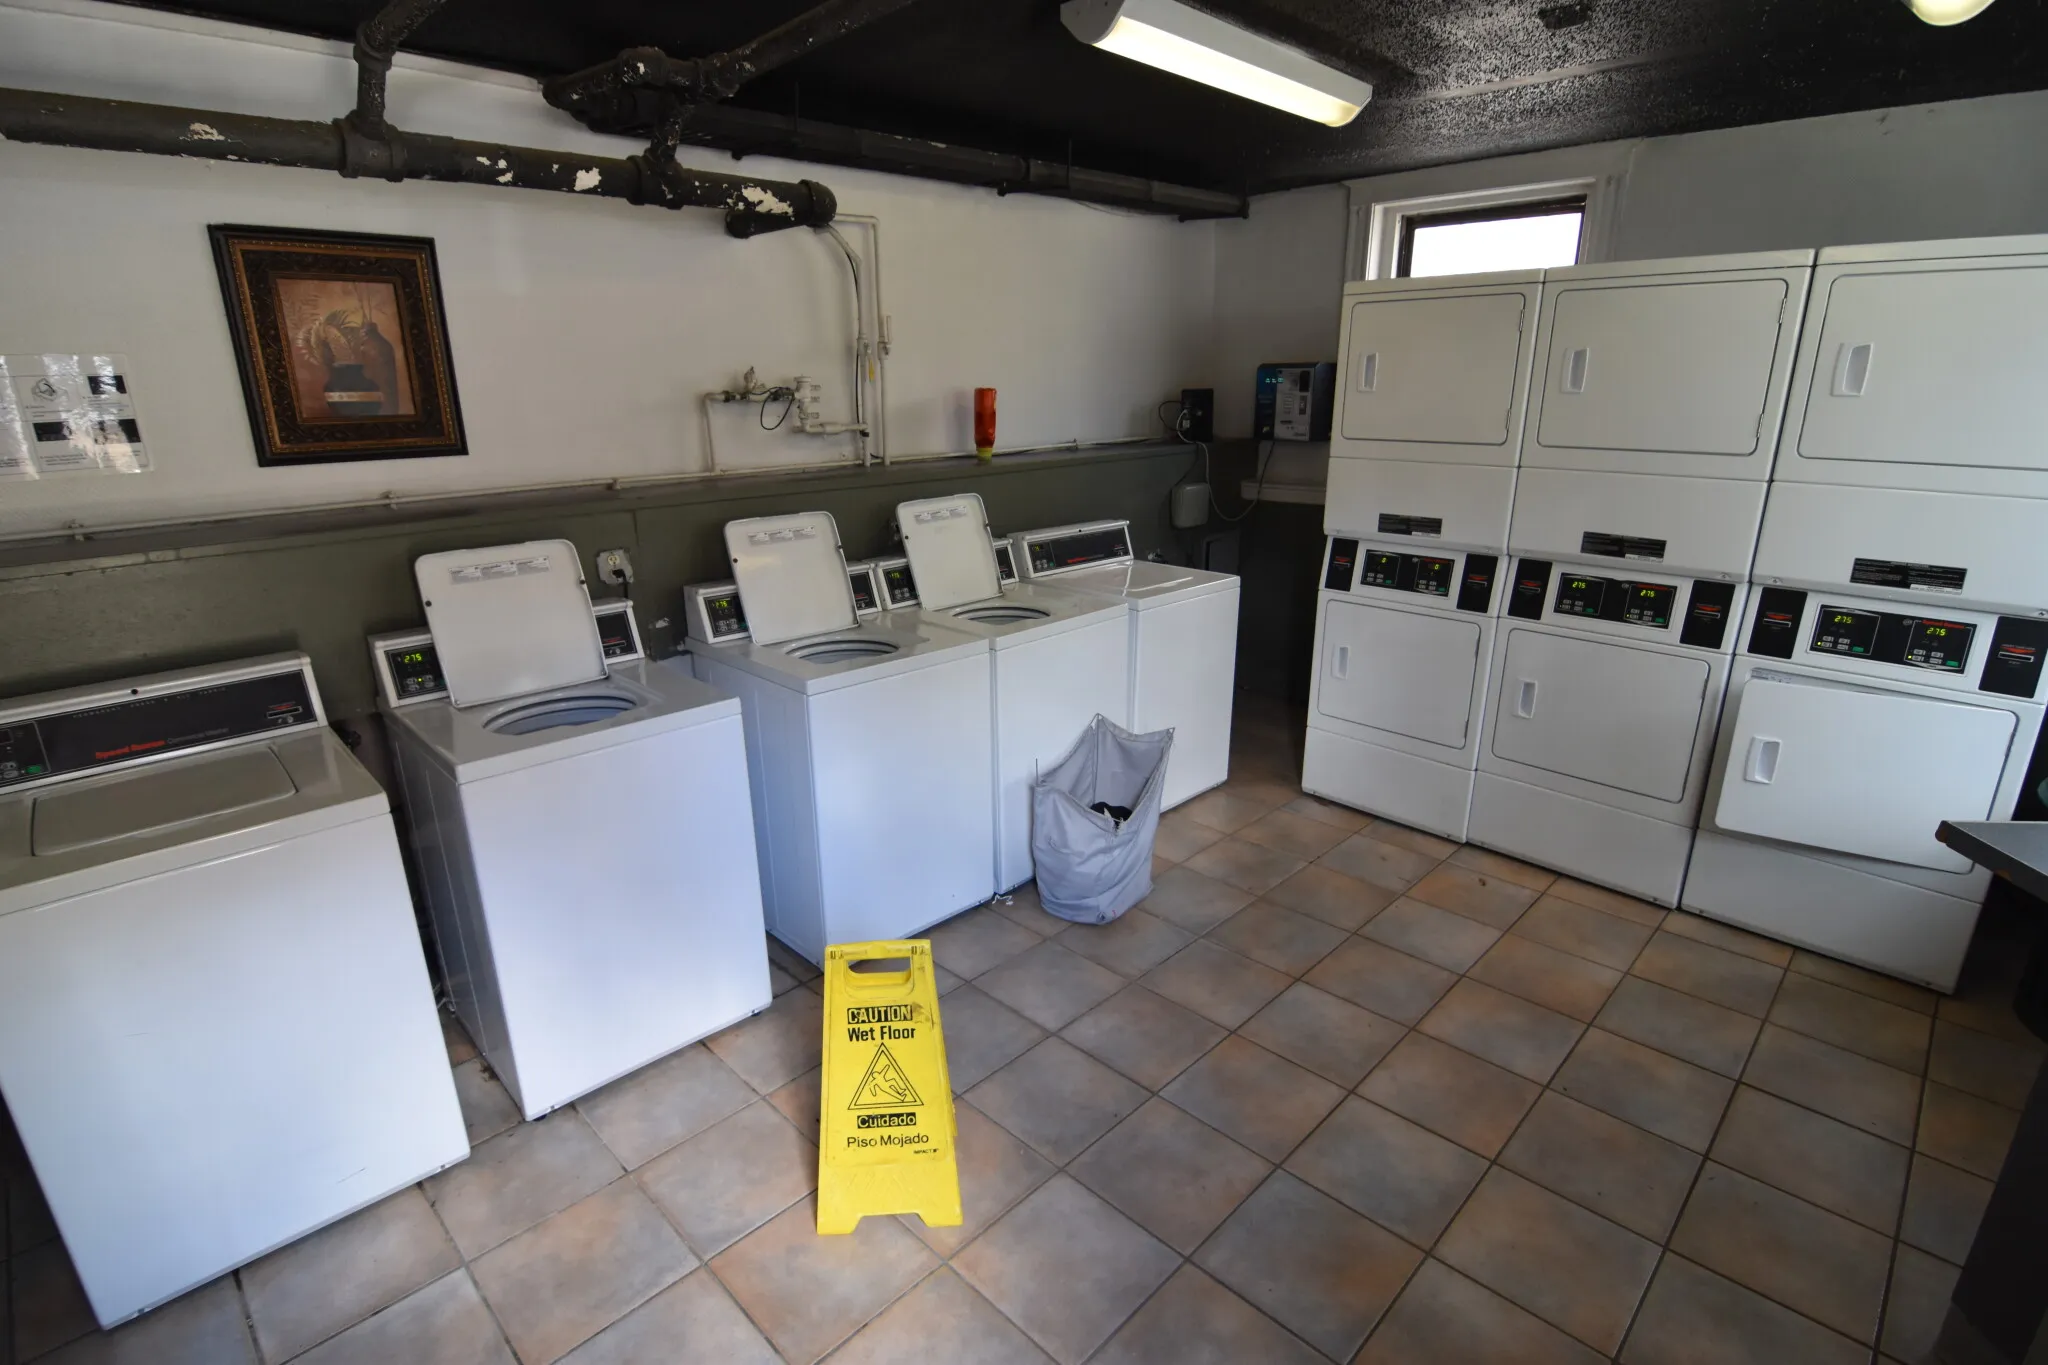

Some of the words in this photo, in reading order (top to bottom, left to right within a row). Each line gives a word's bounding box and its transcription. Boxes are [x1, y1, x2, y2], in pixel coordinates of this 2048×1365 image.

[1572, 581, 1586, 589] 275
[1640, 589, 1655, 598] 275
[1834, 615, 1852, 624] 275
[1926, 627, 1946, 637] 275
[404, 653, 422, 663] 275
[848, 1006, 912, 1023] CAUTION
[848, 1027, 875, 1042] Wet
[879, 1025, 916, 1040] Floor
[858, 1114, 915, 1128] Cuidado
[847, 1135, 877, 1148] Piso
[880, 1132, 929, 1146] Mojado
